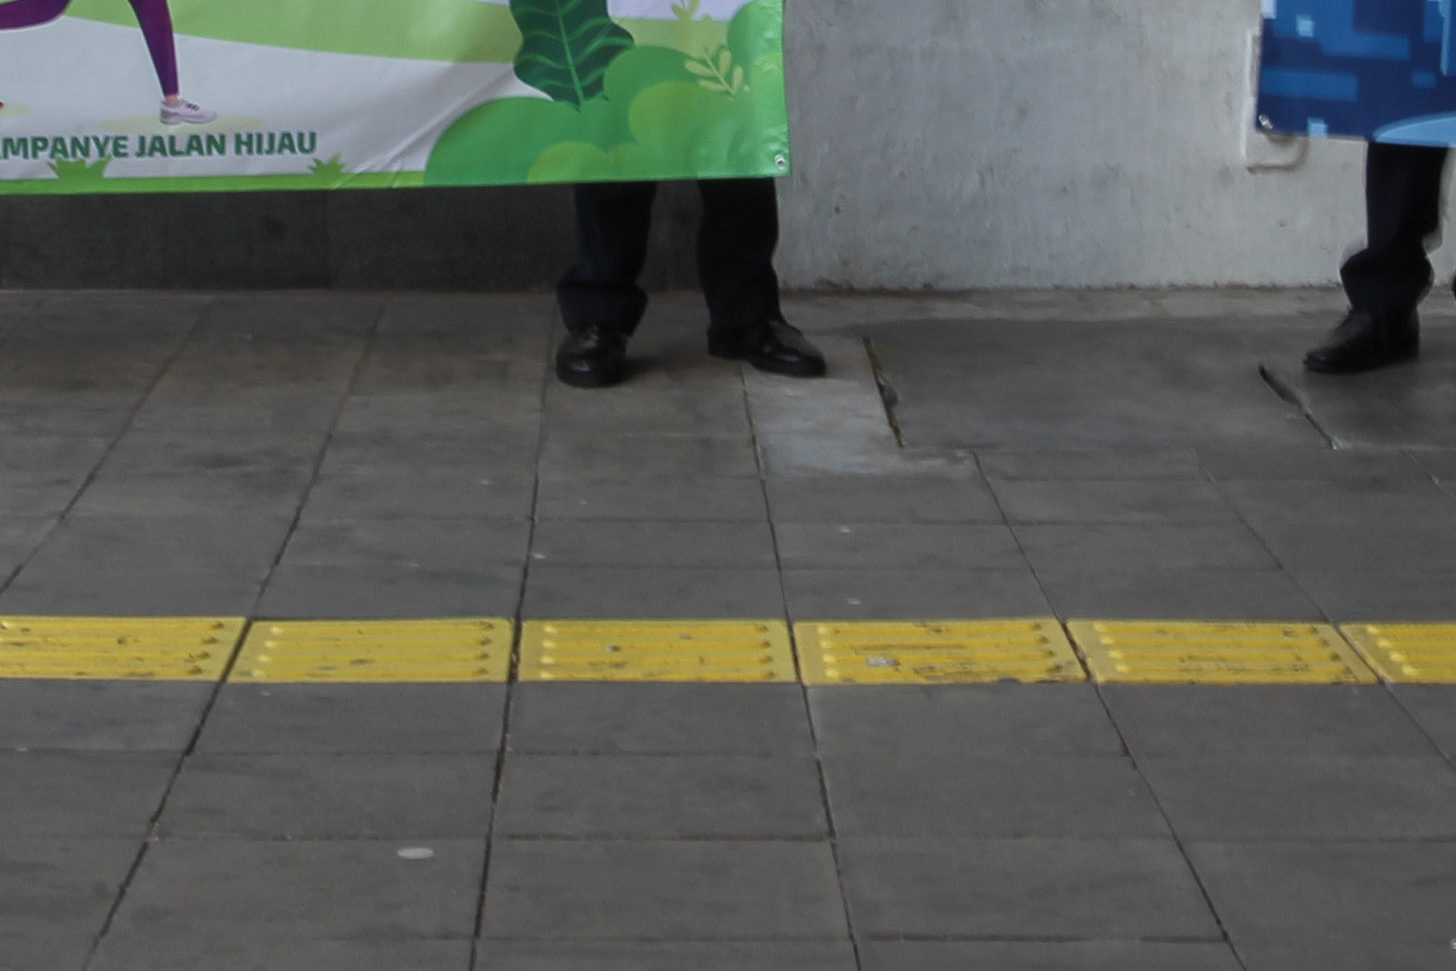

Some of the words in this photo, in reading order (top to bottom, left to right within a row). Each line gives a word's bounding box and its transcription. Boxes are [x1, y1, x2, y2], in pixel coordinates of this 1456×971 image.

[0, 134, 129, 160] MPANYE
[135, 133, 227, 159] JALAN
[234, 131, 319, 157] HIJAU
